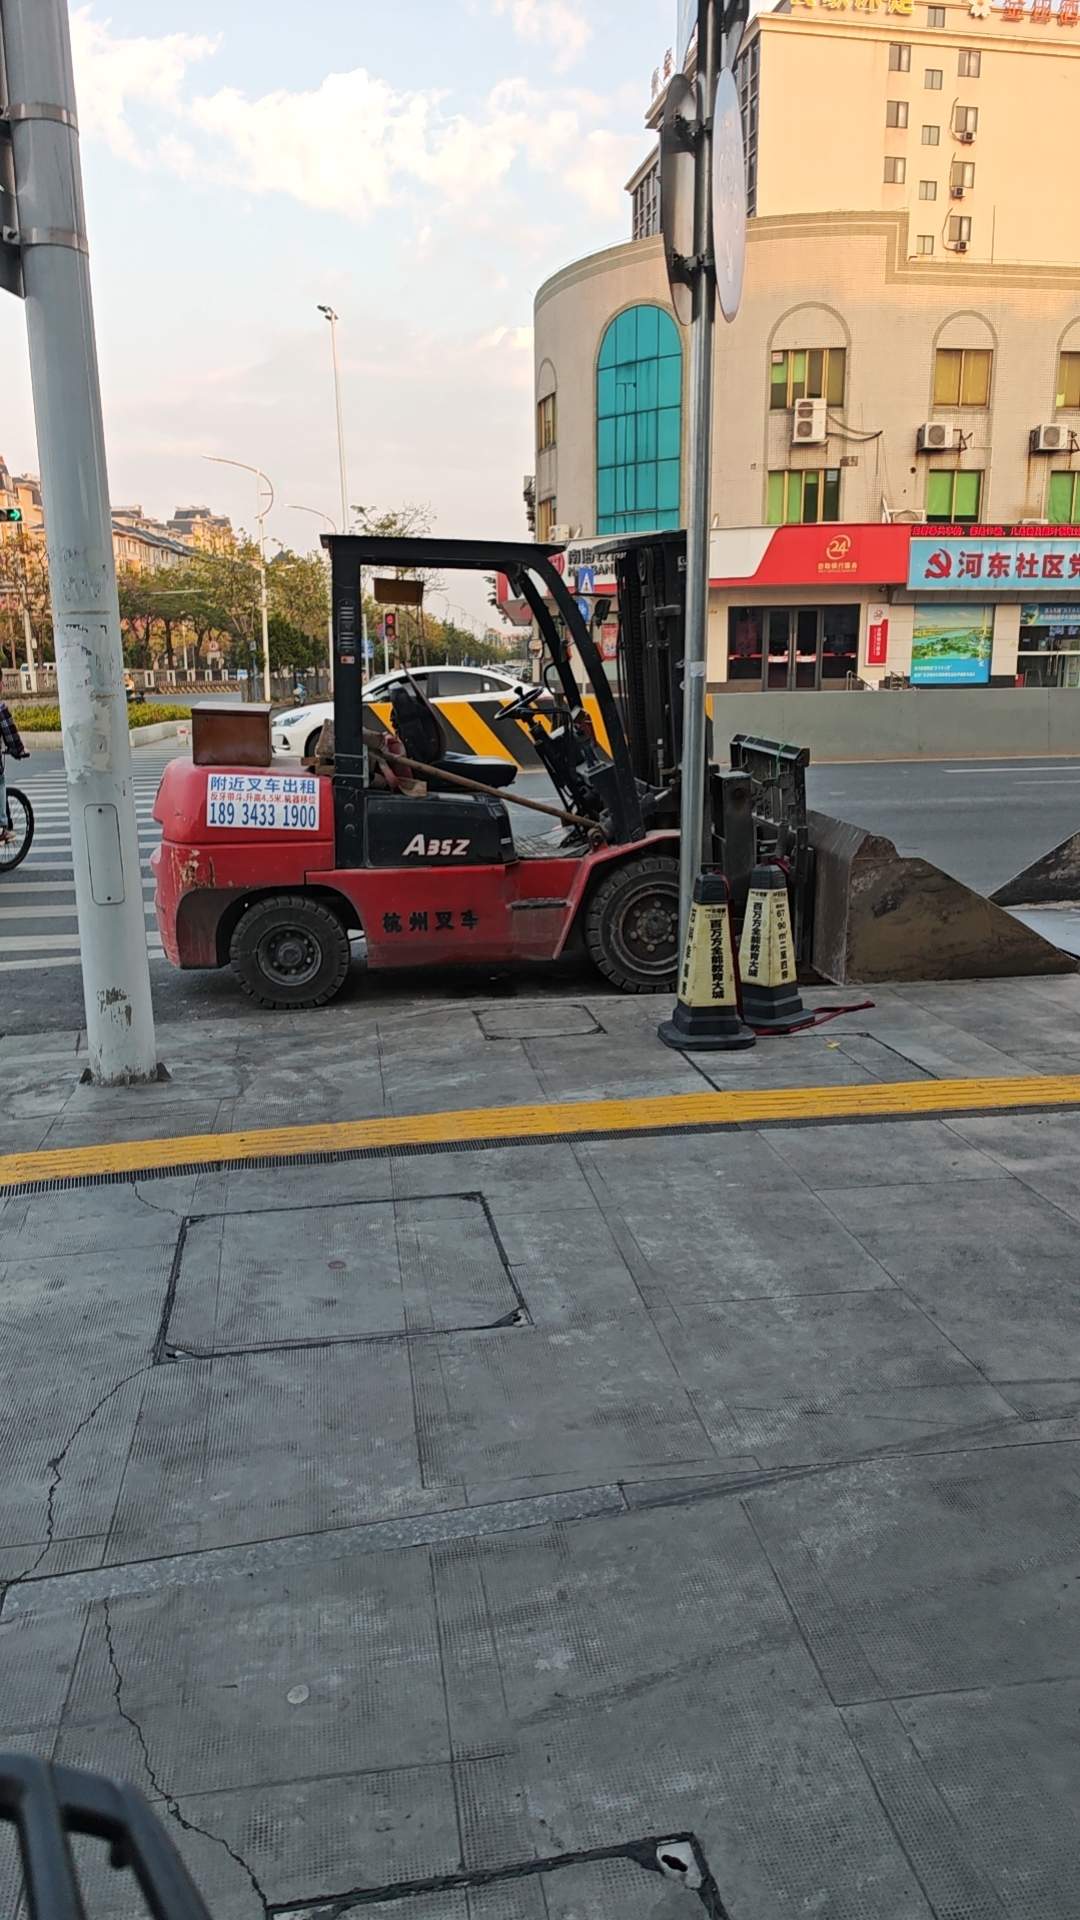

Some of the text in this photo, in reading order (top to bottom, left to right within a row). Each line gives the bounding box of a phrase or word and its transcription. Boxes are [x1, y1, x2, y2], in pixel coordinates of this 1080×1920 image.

[210, 776, 316, 794] 附近叉车出租
[209, 802, 316, 828] 189 3433 1900
[383, 910, 480, 934] 杭州叉车
